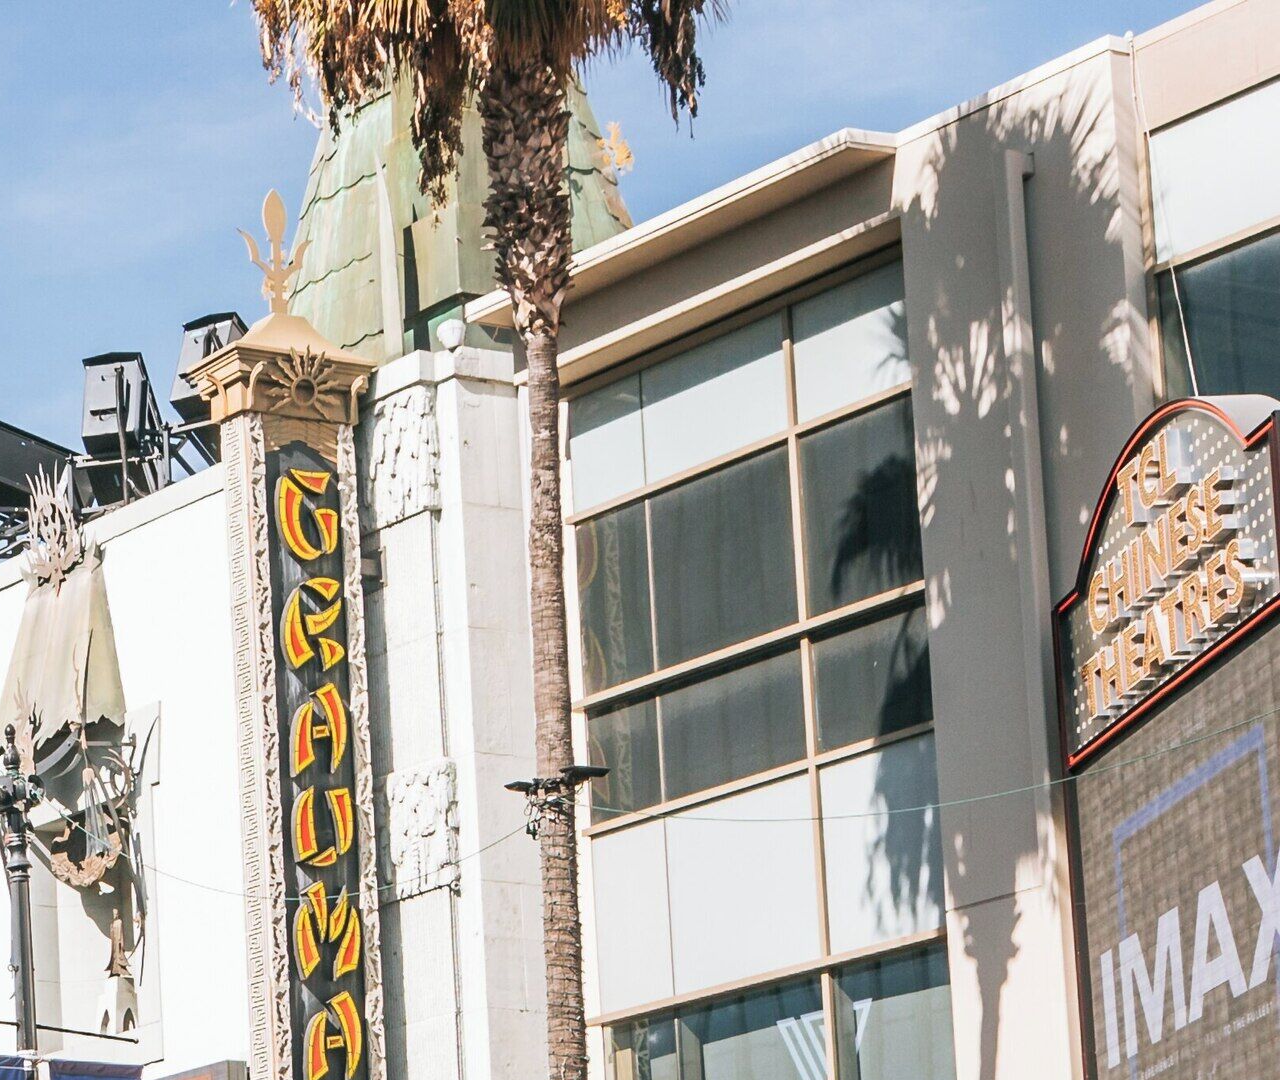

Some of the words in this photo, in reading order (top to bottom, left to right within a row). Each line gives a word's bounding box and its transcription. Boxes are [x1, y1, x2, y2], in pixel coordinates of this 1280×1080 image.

[1088, 466, 1225, 635] CHINESE
[1117, 429, 1180, 528] TCL
[1082, 538, 1245, 720] THEATRES
[1100, 845, 1280, 1070] IMAX
